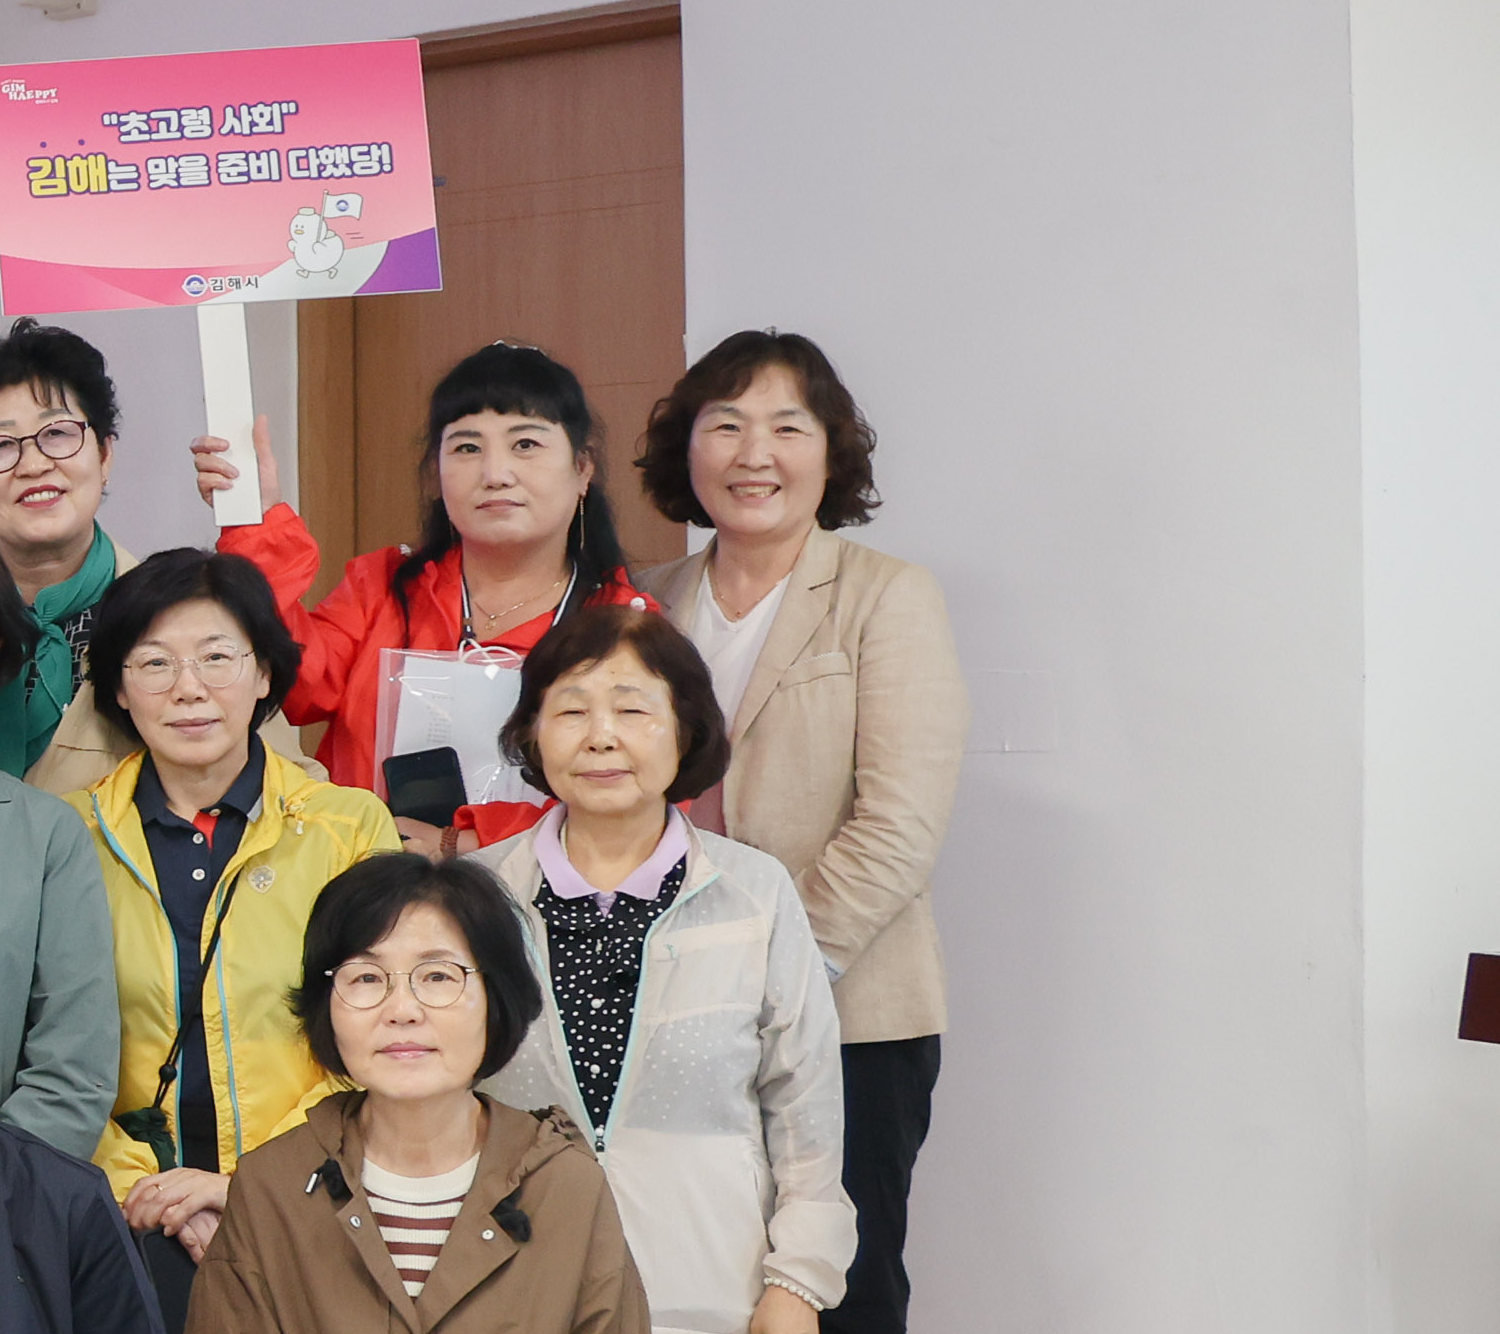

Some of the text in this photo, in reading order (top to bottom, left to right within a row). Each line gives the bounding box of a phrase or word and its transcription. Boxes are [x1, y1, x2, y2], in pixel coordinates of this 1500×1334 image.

[1, 83, 26, 93] GIM
[102, 101, 298, 143] "초고령 사회"
[27, 143, 393, 197] 김해는 맞을 준비 다했당!
[209, 275, 259, 291] 김해시
